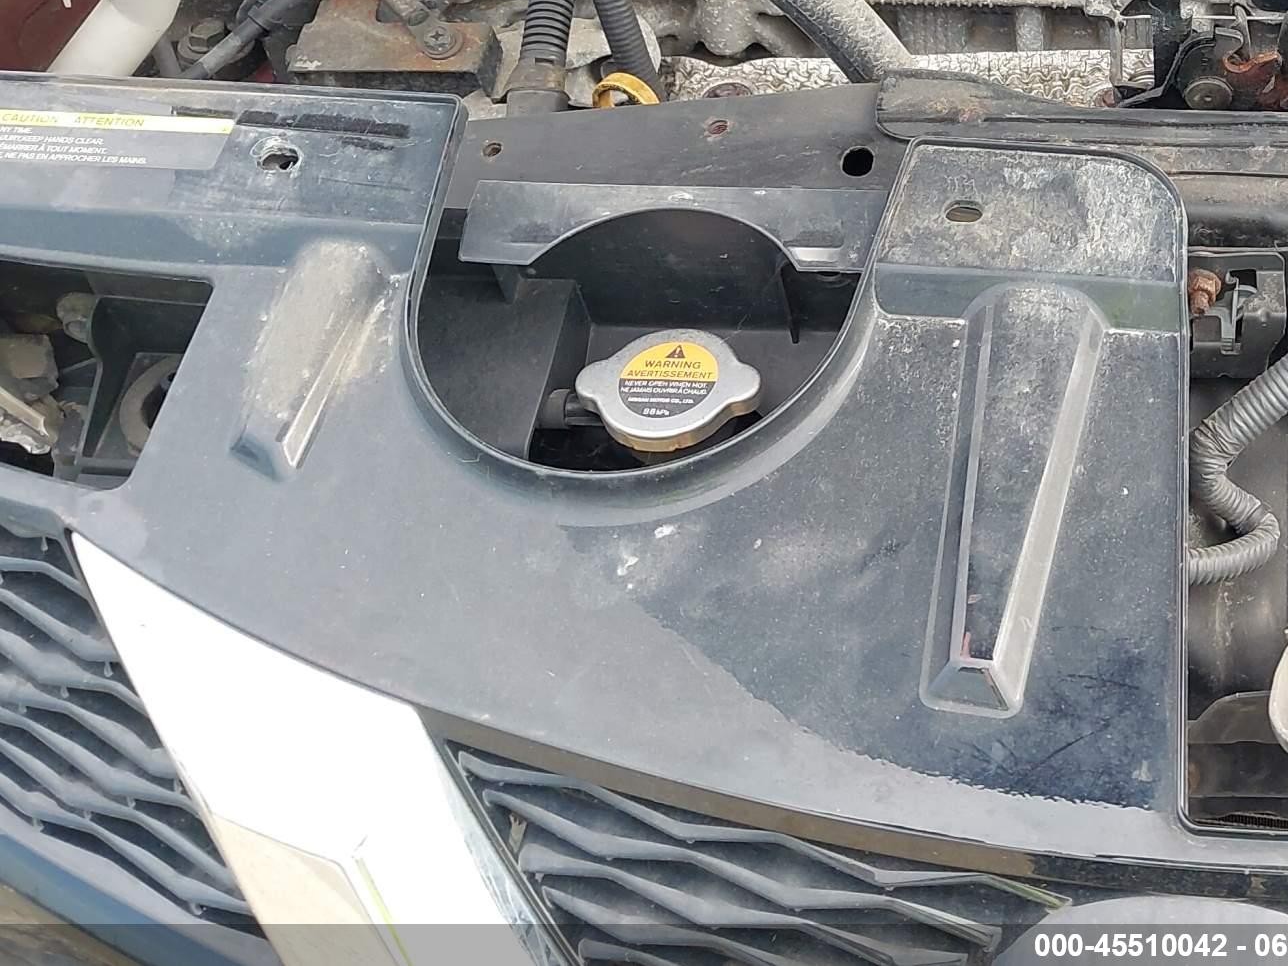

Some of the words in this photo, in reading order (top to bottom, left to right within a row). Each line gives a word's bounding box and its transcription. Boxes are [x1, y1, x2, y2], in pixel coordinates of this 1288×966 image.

[2, 112, 58, 123] CAUTION
[74, 114, 145, 126] ATTENTION
[47, 145, 69, 153] TOUT
[48, 153, 102, 163] APPROCHER
[645, 360, 702, 369] WARNING
[627, 370, 713, 379] AVERTISSEMENT
